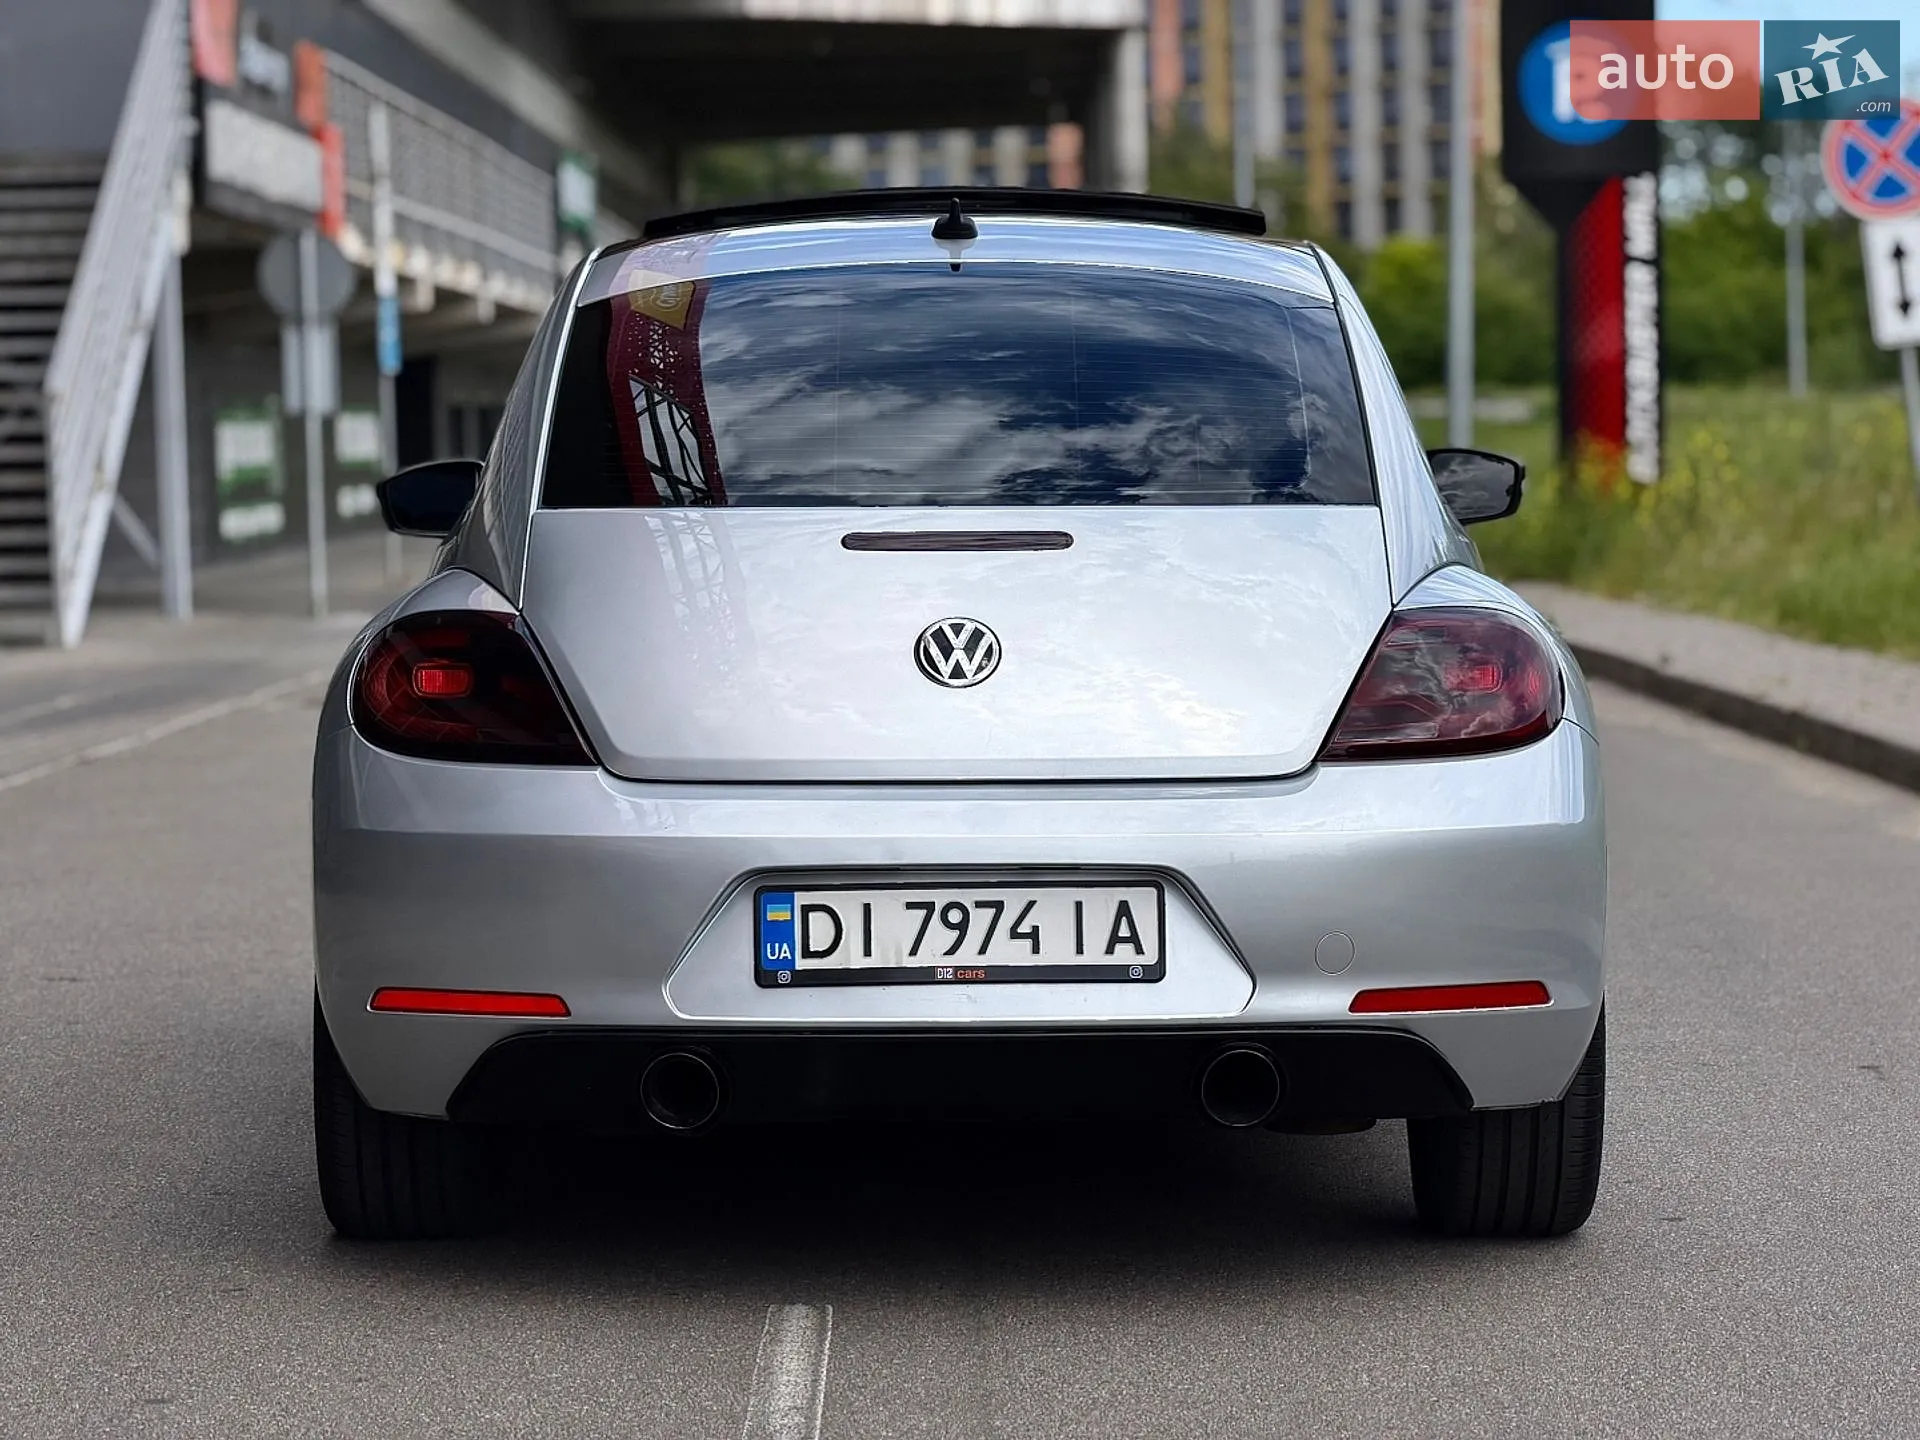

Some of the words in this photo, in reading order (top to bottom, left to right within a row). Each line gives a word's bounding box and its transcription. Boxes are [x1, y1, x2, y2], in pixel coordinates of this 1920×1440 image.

[919, 619, 998, 685] VW
[800, 902, 873, 959] DI
[905, 900, 1040, 957] 7974
[1075, 900, 1145, 955] IA
[766, 942, 792, 960] UA
[957, 969, 985, 979] cars
